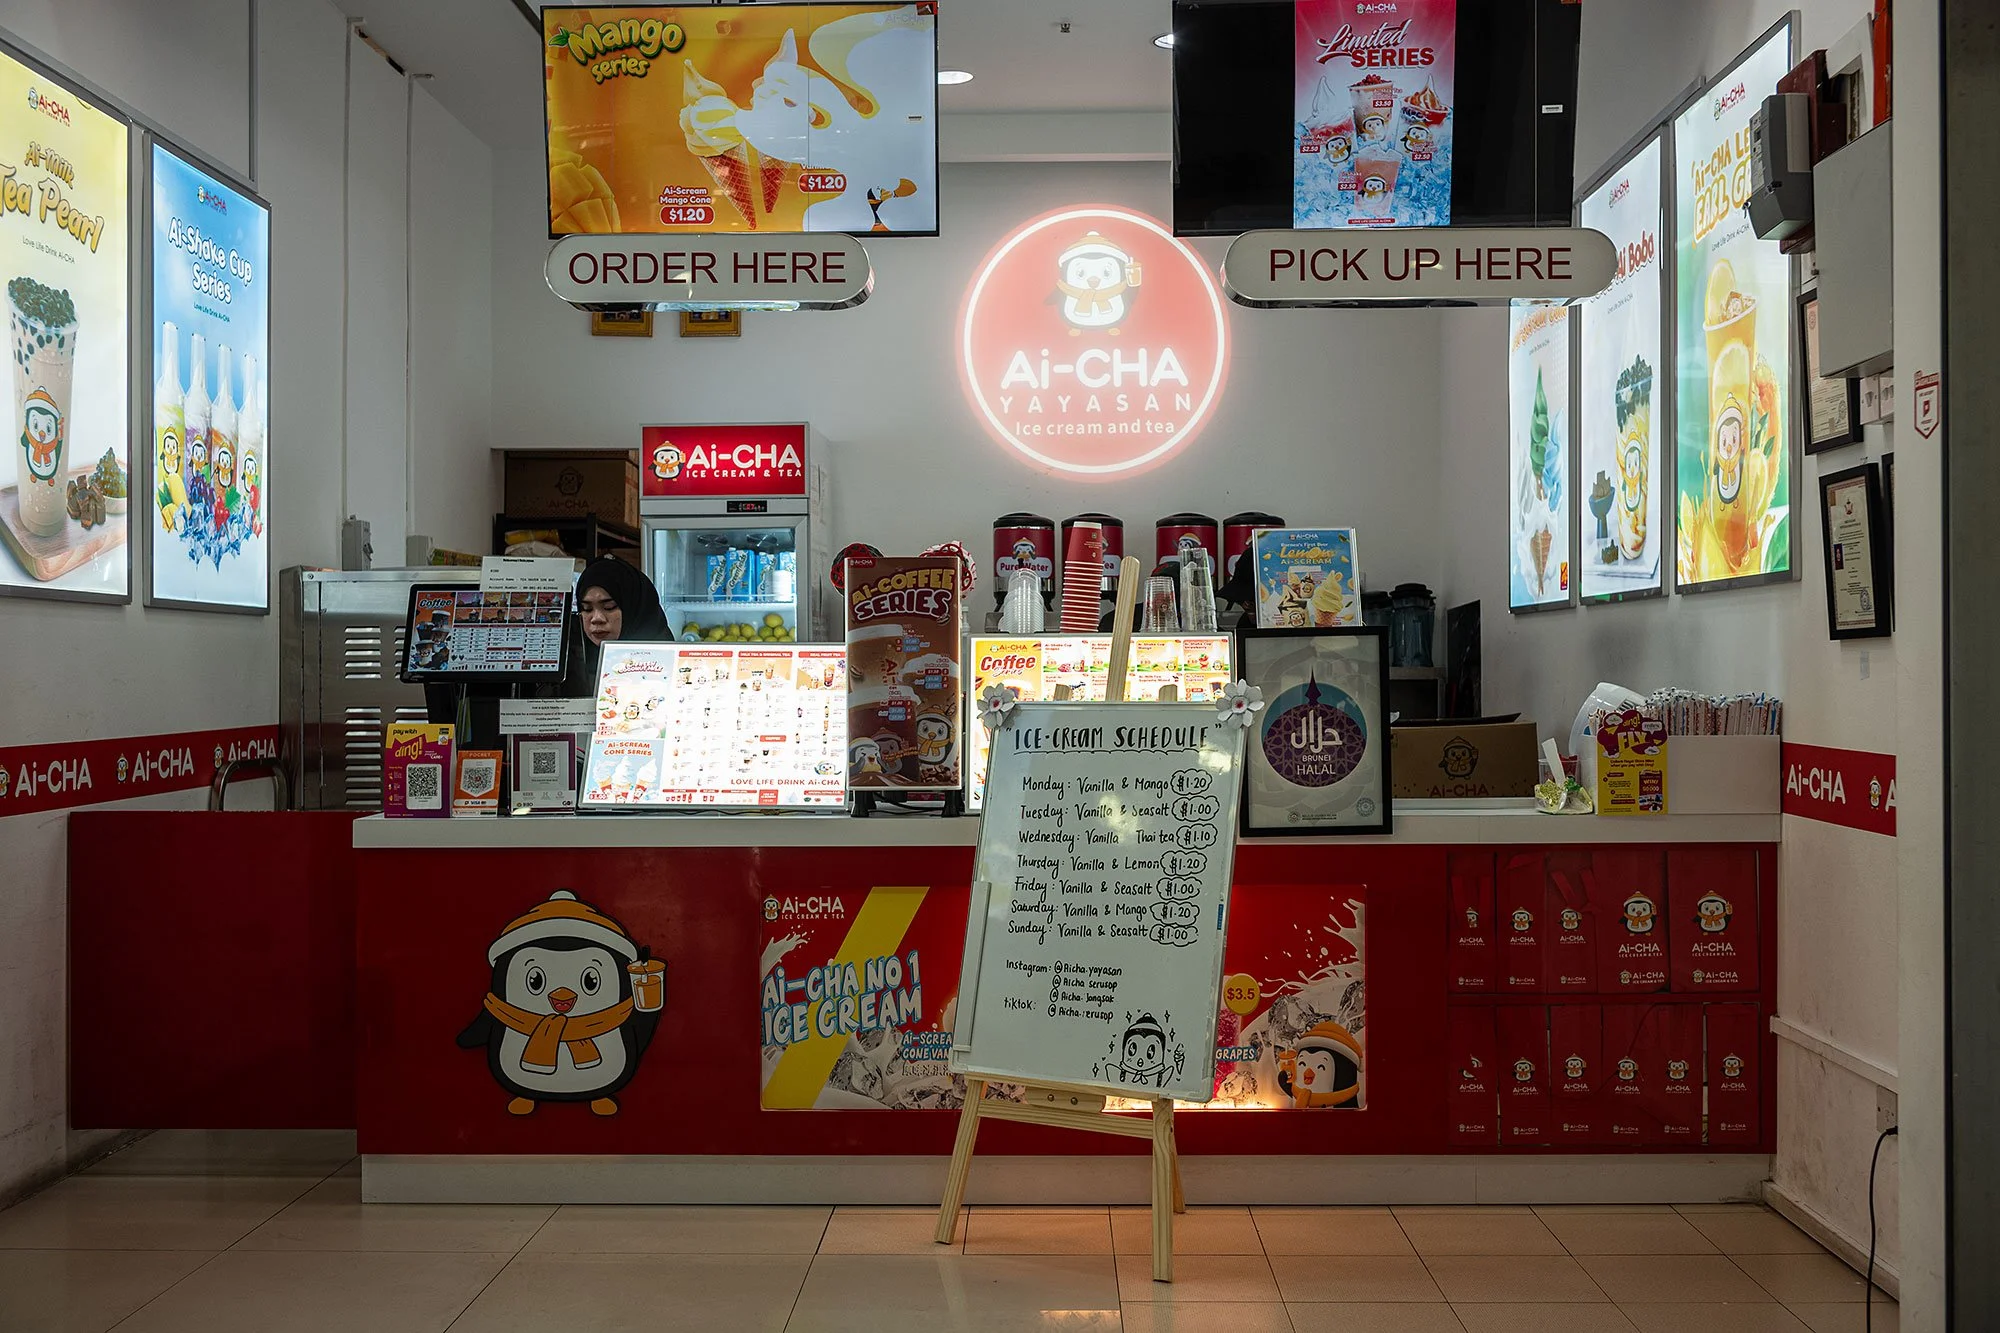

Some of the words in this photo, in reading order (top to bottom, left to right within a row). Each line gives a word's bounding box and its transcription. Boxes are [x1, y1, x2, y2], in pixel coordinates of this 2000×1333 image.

[1365, 3, 1397, 11] Ai-CHA
[567, 18, 686, 66] Mango
[1316, 18, 1412, 65] Limited
[1351, 47, 1435, 68] SERIES
[591, 53, 650, 84] series
[1721, 82, 1746, 109] Ai-CHA
[38, 94, 71, 123] Ai-CHA
[1735, 127, 1751, 161] LE
[24, 141, 75, 189] Ai-Milk
[663, 186, 708, 196] Ai-Scream
[808, 176, 845, 190] $1.20
[0, 163, 33, 217] Tea
[38, 177, 105, 253] Pearl
[204, 190, 228, 210] Ai-CHA
[660, 196, 688, 206] Mango
[689, 196, 712, 204] Cone
[669, 208, 706, 222] $1.20
[22, 236, 35, 250] Love
[44, 244, 58, 258] Drink
[58, 250, 75, 265] Ai-CHA
[168, 217, 227, 269] Ai-Shake
[229, 249, 253, 287] Cup
[1629, 230, 1655, 273] Boba
[568, 252, 719, 285] ORDER
[732, 252, 847, 284] HERE
[1269, 248, 1368, 282] PICK
[1384, 248, 1440, 282] UP
[1455, 247, 1573, 281] HERE
[192, 262, 232, 304] Series
[1000, 347, 1189, 389] Ai-CHA
[1000, 393, 1191, 414] YAYASAN
[1016, 421, 1042, 436] Ice
[1046, 422, 1102, 436] cream
[1107, 418, 1141, 434] and
[1145, 419, 1175, 434] tea
[686, 444, 802, 469] Ai-CHA
[686, 469, 706, 478] ICE
[713, 469, 756, 478] CREAM
[763, 469, 771, 477] &
[779, 469, 802, 477] TEA
[1279, 547, 1336, 559] Lemon
[729, 554, 747, 588] Greenfields
[1025, 562, 1049, 572] Water
[1103, 561, 1114, 570] ea
[852, 568, 956, 605] Ai-COFFEE
[419, 598, 453, 608] Coffee
[854, 588, 952, 621] SERIES
[981, 654, 1036, 671] Coffee
[1291, 709, 1343, 754] حلال
[1617, 732, 1648, 750] FLY
[395, 737, 423, 760] ding!
[608, 741, 651, 749] Ai-SCREAM
[132, 747, 194, 783] Ai-CHA
[1297, 764, 1336, 775] HALAL
[14, 758, 92, 798] Ai-CHA
[1077, 776, 1115, 795] Vanilla
[1121, 776, 1129, 789] &
[1134, 777, 1169, 799] Mango
[1176, 775, 1207, 791] $1.20
[1786, 764, 1846, 804] Ai-CHA
[1430, 784, 1489, 798] Ai-CHA
[1074, 803, 1113, 820] Vanilla
[1119, 804, 1127, 816] &
[1131, 804, 1169, 818] Seasalt
[1180, 804, 1212, 817] $1.00
[1018, 829, 1080, 853] Wednesday:
[1085, 828, 1120, 845] Vanilla
[1136, 828, 1156, 844] Thai
[1159, 829, 1175, 843] tea
[1183, 830, 1211, 844] $1.10
[1070, 856, 1105, 872] Vanilla
[1112, 858, 1119, 870] &
[1124, 855, 1160, 870] Lemon
[1169, 856, 1201, 873] $1.20
[1059, 879, 1093, 895] Vanilla
[1100, 881, 1108, 892] &
[1114, 882, 1153, 896] Seasalt
[1165, 881, 1195, 896] $1.00
[782, 896, 845, 915] Ai-CHA
[1063, 903, 1098, 918] Vanilla
[1104, 904, 1111, 916] &
[1116, 903, 1147, 922] Mango
[1160, 904, 1191, 919] $1.20
[1057, 923, 1092, 938] Vanilla
[1098, 925, 1105, 936] &
[1110, 925, 1148, 938] Seasalt
[1157, 929, 1188, 942] $1.00
[1618, 943, 1660, 953] Ai-CHA
[1692, 942, 1733, 952] Ai-CHA
[1006, 960, 1051, 978] Instagram:
[761, 961, 859, 1011] Ai-CHA
[865, 955, 903, 992] NO
[906, 950, 921, 985] 1
[1226, 987, 1255, 1001] $3.5
[762, 1002, 809, 1047] ICE
[816, 985, 923, 1038] CREAM
[902, 1032, 953, 1045] Ai-SCREA
[902, 1048, 929, 1059] CONE
[931, 1048, 949, 1059] VAN
[1216, 1049, 1255, 1060] GRAPES
